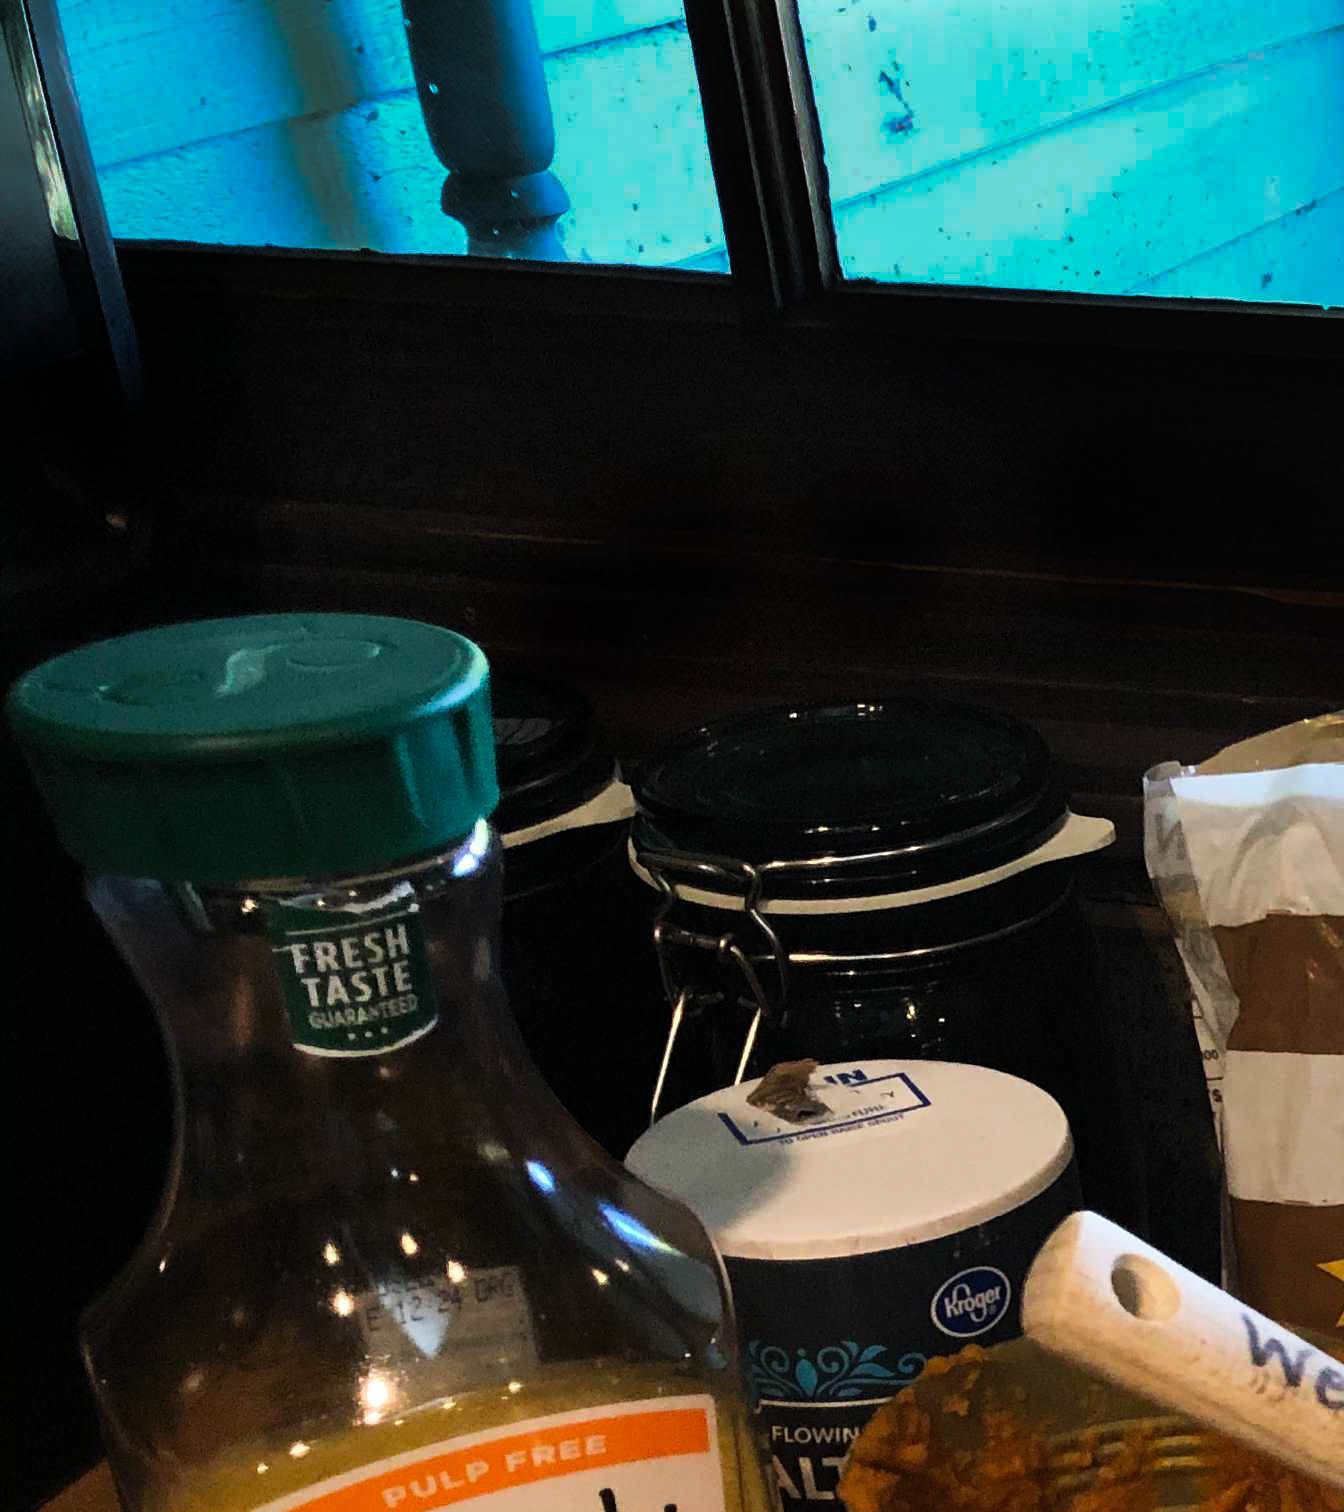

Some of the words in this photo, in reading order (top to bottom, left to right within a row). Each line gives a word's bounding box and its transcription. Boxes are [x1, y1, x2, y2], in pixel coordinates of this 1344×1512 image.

[289, 924, 410, 974] FRESH
[301, 960, 412, 1007] TASTE
[308, 994, 419, 1029] GUARANTEED
[944, 1282, 1001, 1322] Kroger
[771, 1425, 860, 1444] FLOWIN
[382, 1461, 490, 1509] PULP
[505, 1434, 608, 1473] FREE
[771, 1454, 850, 1500] ALT
